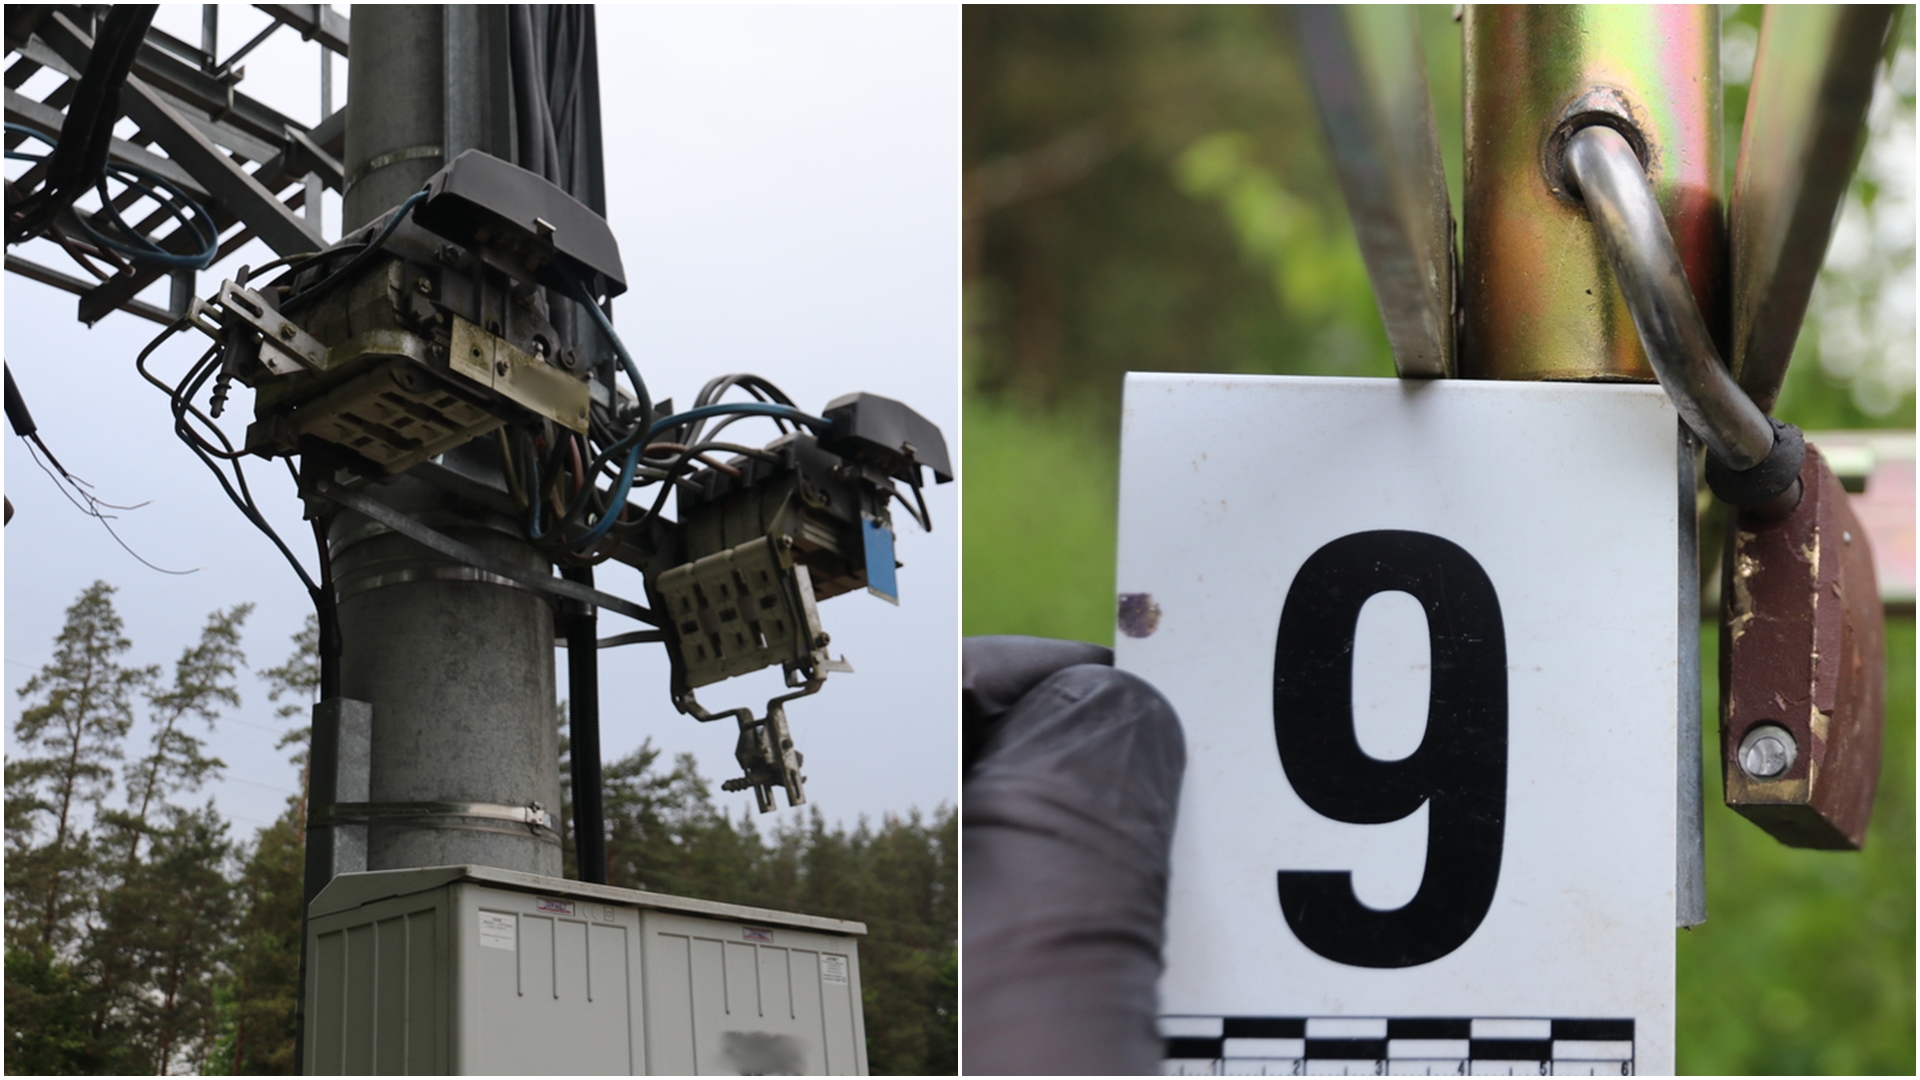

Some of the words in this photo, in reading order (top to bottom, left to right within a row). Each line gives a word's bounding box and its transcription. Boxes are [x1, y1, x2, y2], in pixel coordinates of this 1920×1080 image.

[1273, 530, 1508, 969] 9
[1293, 1059, 1301, 1076] 2
[1375, 1059, 1383, 1076] 3
[1457, 1059, 1465, 1076] 4
[1540, 1060, 1548, 1076] 5
[1620, 1060, 1629, 1076] 6
